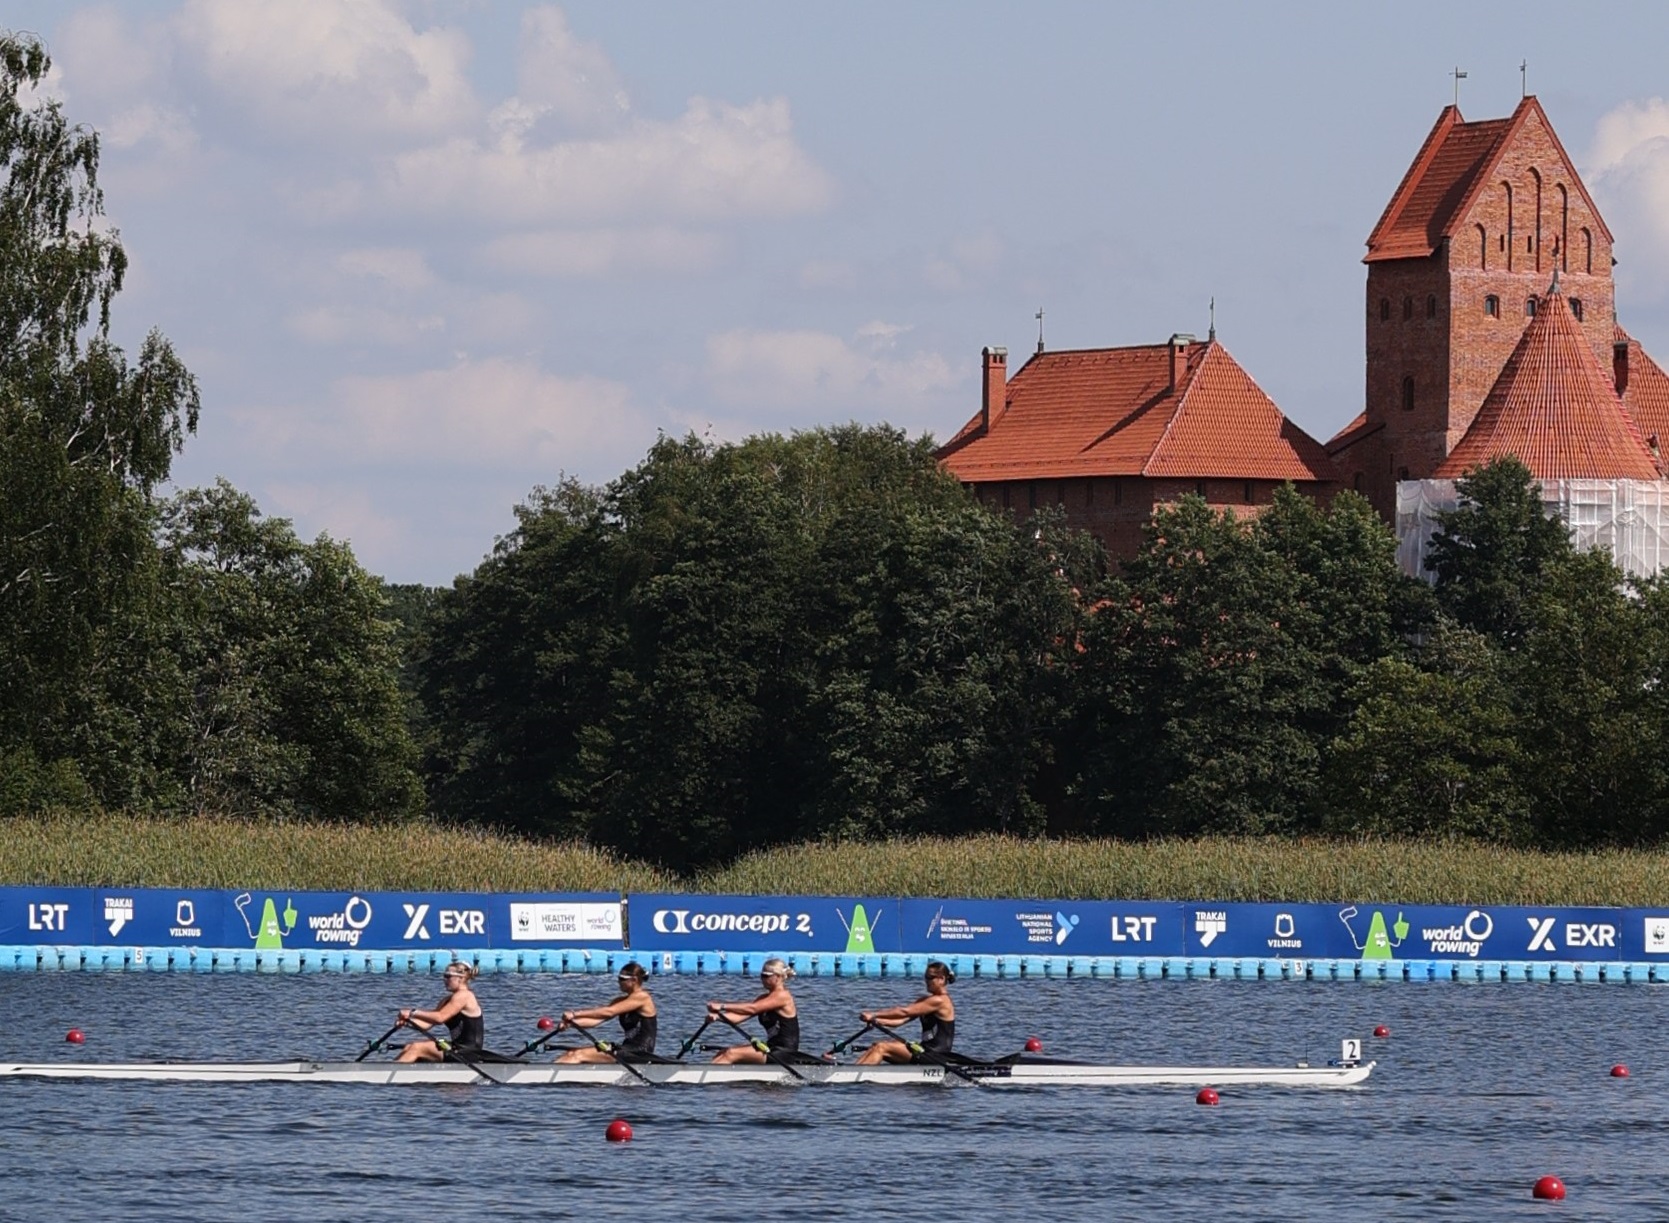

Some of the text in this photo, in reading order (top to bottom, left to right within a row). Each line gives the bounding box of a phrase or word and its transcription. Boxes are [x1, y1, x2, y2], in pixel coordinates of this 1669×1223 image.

[104, 898, 133, 908] TRAKAI
[28, 904, 69, 931] LRT
[308, 913, 344, 929] world
[439, 910, 485, 934] EXR
[541, 914, 575, 923] HEALTHY
[691, 913, 789, 934] concept
[1195, 911, 1226, 921] TRAKAI
[169, 928, 201, 938] VILNIUS
[544, 923, 576, 932] WATERS
[1111, 916, 1156, 941] LRT
[1422, 926, 1464, 941] world
[1565, 923, 1616, 947] EXR
[315, 929, 359, 946] rowing
[1267, 938, 1302, 948] VILNIUS
[1430, 940, 1480, 957] rowing
[923, 1068, 943, 1077] NZL
